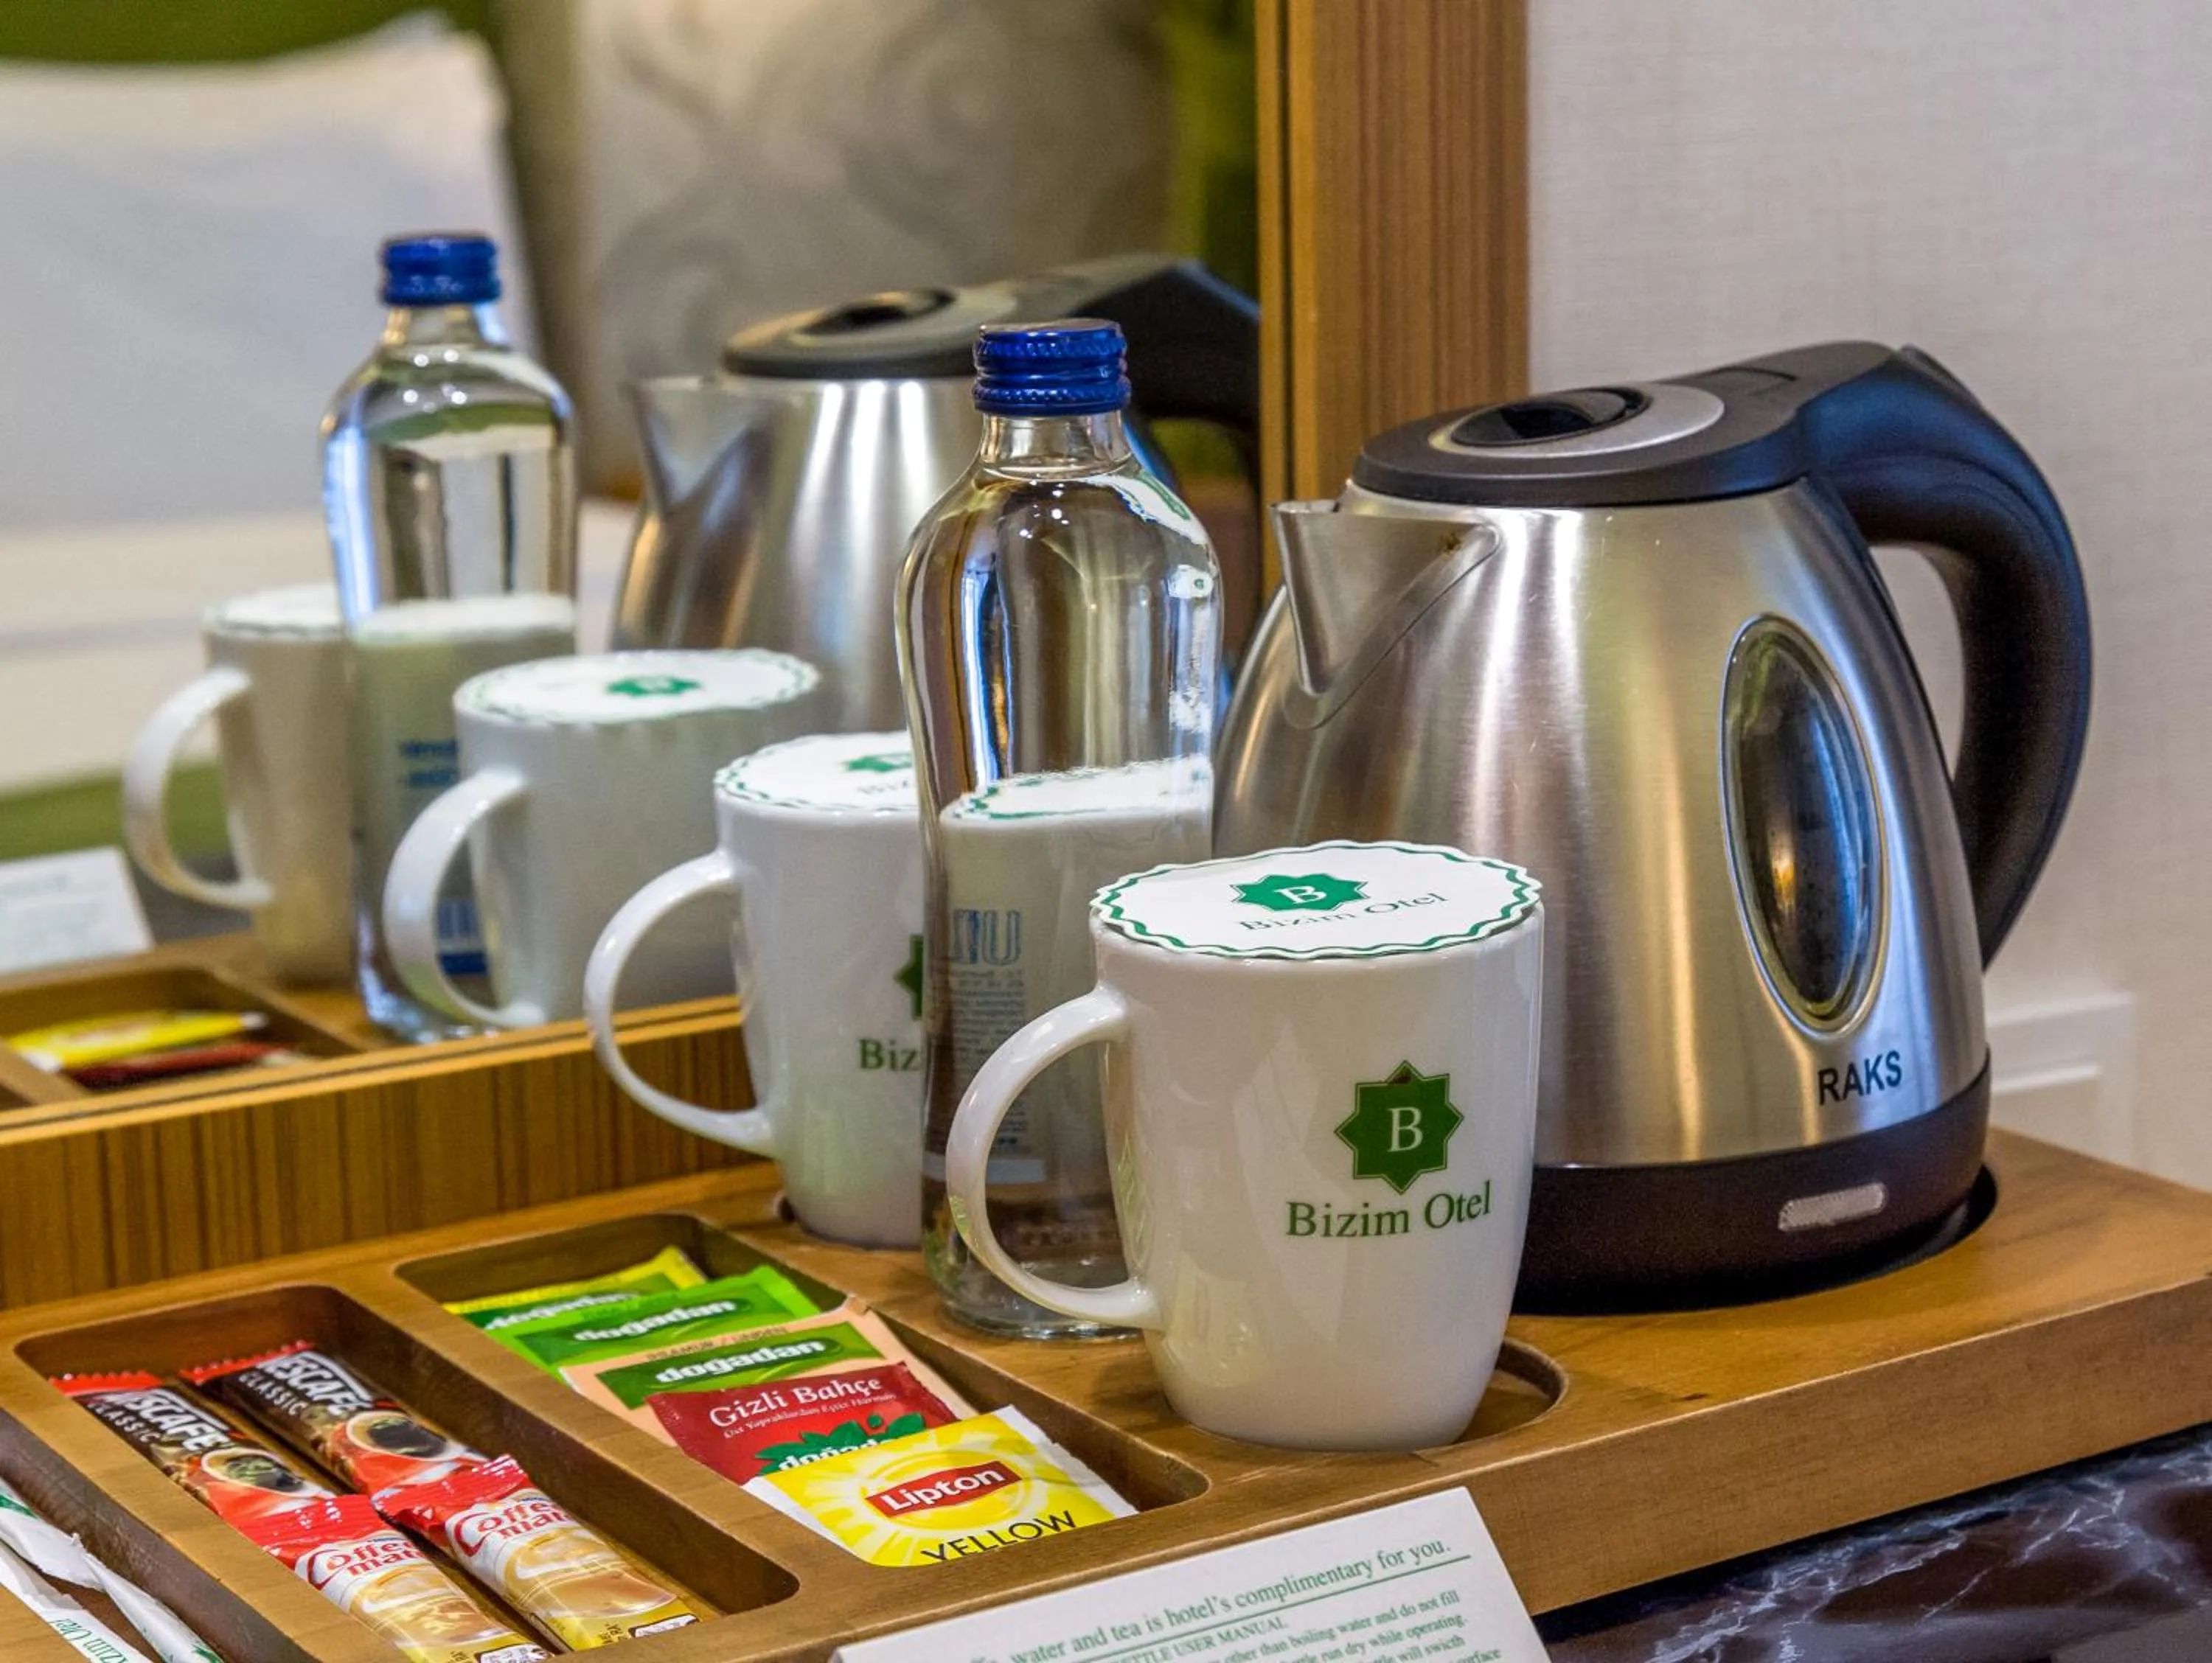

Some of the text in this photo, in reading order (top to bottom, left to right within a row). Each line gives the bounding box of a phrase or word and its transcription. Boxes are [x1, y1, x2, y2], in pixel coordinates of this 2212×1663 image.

[1239, 892, 1449, 930] Bizim Otel
[1274, 885, 1326, 904] B
[859, 1039, 919, 1071] Biz
[1817, 1050, 1902, 1106] RAKS
[1387, 1106, 1424, 1152] B
[1286, 1179, 1492, 1238] Bizim Otel
[237, 1372, 309, 1416] CLASSIC
[709, 1377, 883, 1428] Gizli Bahçe
[880, 1469, 1005, 1510] Lipton
[919, 1510, 1077, 1561] YELLOW
[1071, 1626, 1107, 1653] and
[1110, 1622, 1143, 1642] tea
[1144, 1614, 1164, 1633] is
[1164, 1594, 1231, 1627] hotel's
[1234, 1558, 1374, 1608] complimentary
[1376, 1549, 1405, 1569] for
[1408, 1539, 1451, 1566] you.
[1174, 1634, 1216, 1656] USER
[1217, 1616, 1289, 1645] MANUAL
[1259, 1639, 1289, 1656] than
[1288, 1627, 1337, 1649] boiling
[1338, 1617, 1373, 1634] water
[1375, 1606, 1399, 1625] and
[1399, 1603, 1417, 1618] do
[1418, 1595, 1441, 1613] not
[1439, 1589, 1461, 1607] fill
[1344, 1641, 1367, 1658] dry
[1368, 1629, 1404, 1648] while
[1405, 1613, 1468, 1639] operating.
[1397, 1644, 1423, 1662] will
